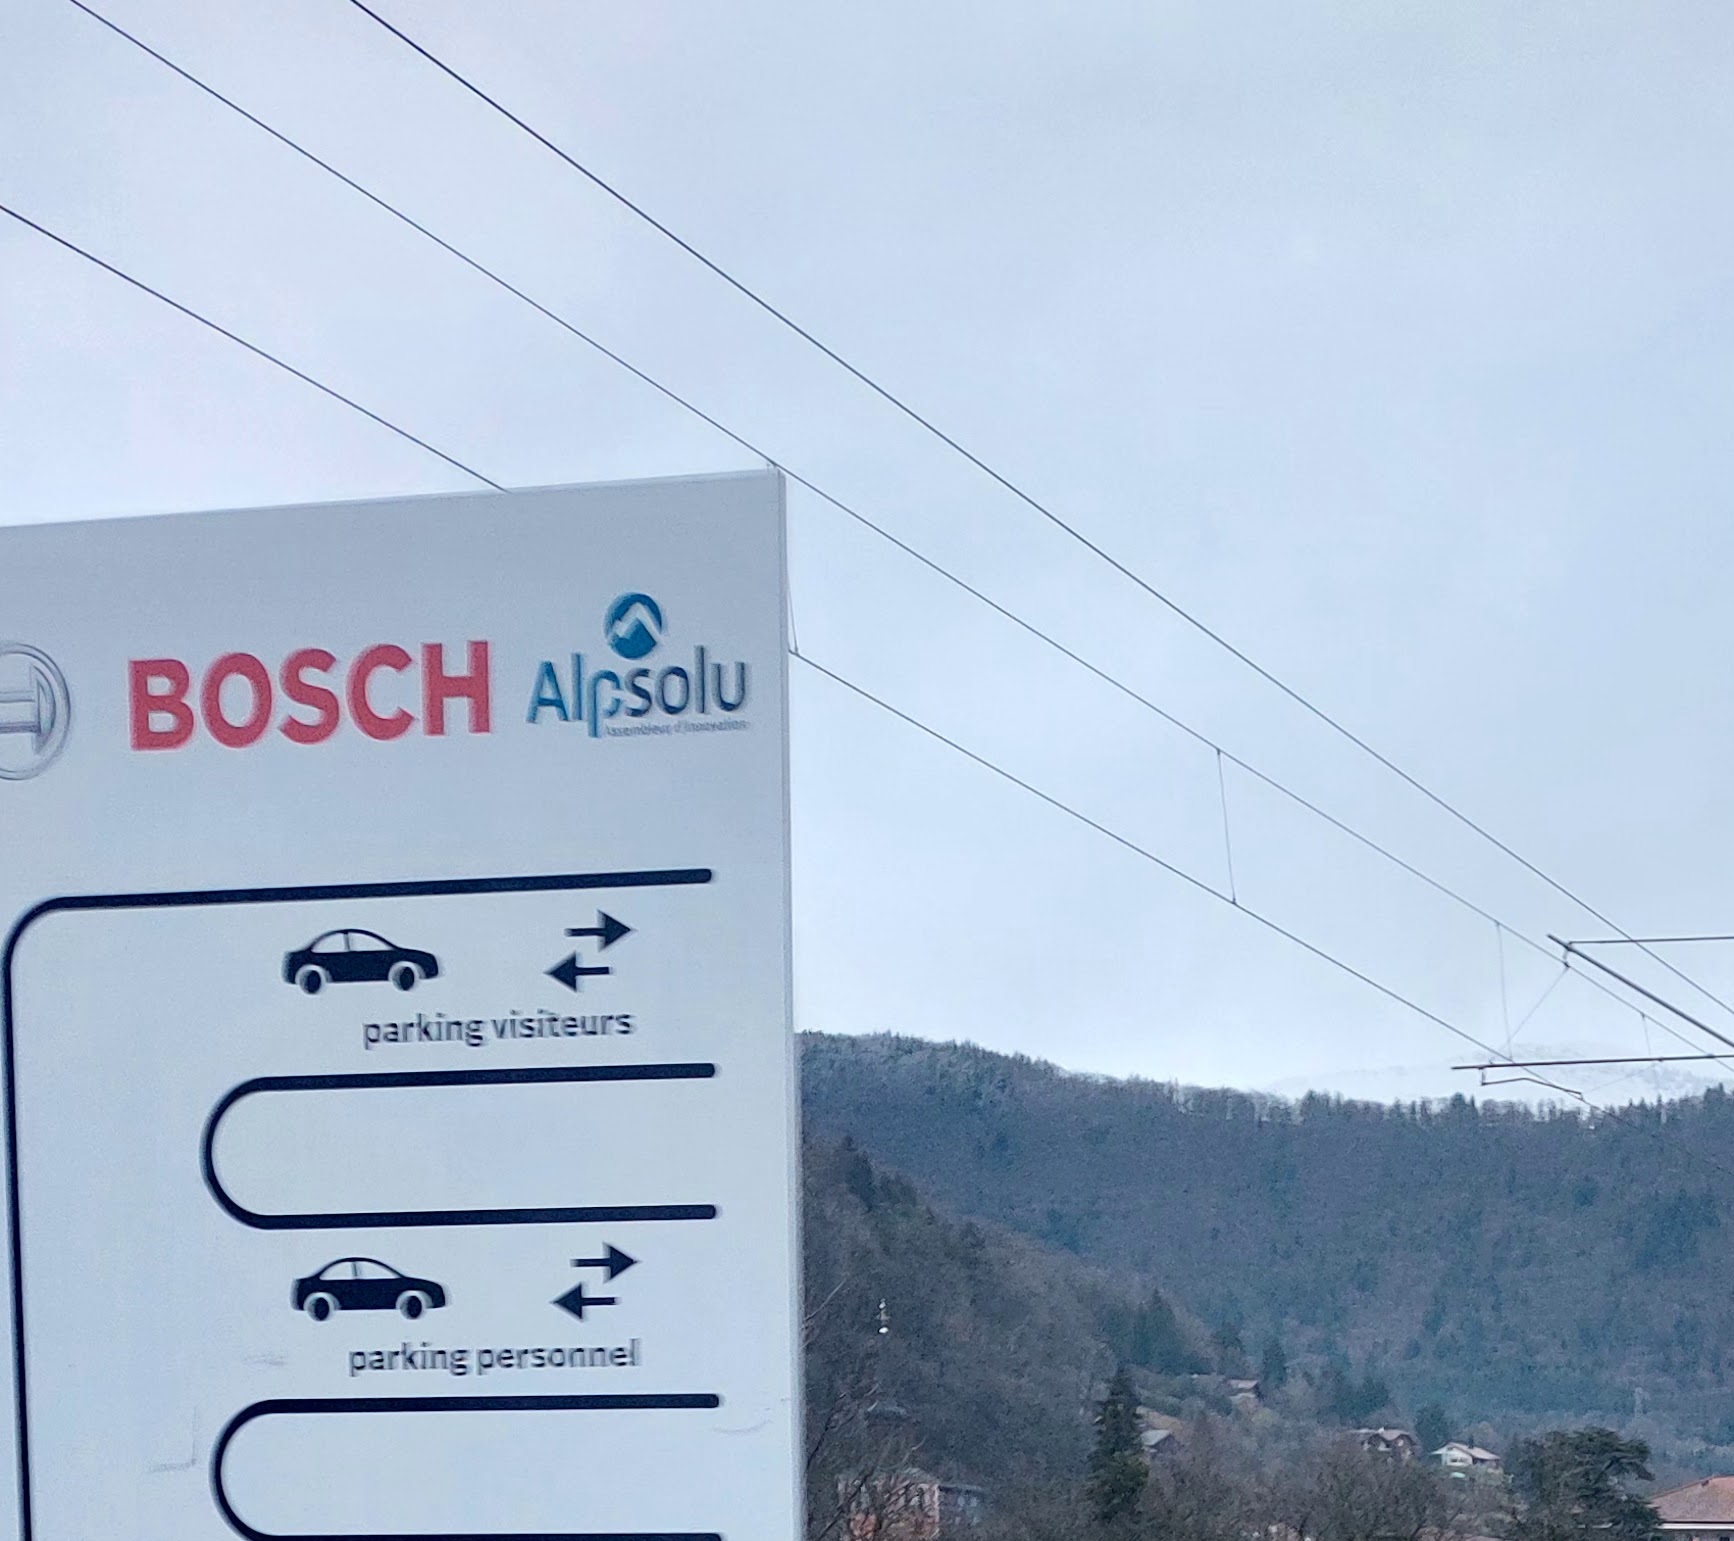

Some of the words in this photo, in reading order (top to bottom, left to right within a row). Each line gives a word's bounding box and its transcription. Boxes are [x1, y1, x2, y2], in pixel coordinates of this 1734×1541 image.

[128, 639, 491, 750] BOSCH
[526, 645, 749, 738] Alpsolu
[362, 1012, 485, 1050] parking
[491, 1009, 635, 1039] visiteurs
[349, 1341, 469, 1377] parking
[476, 1338, 642, 1376] personnel
